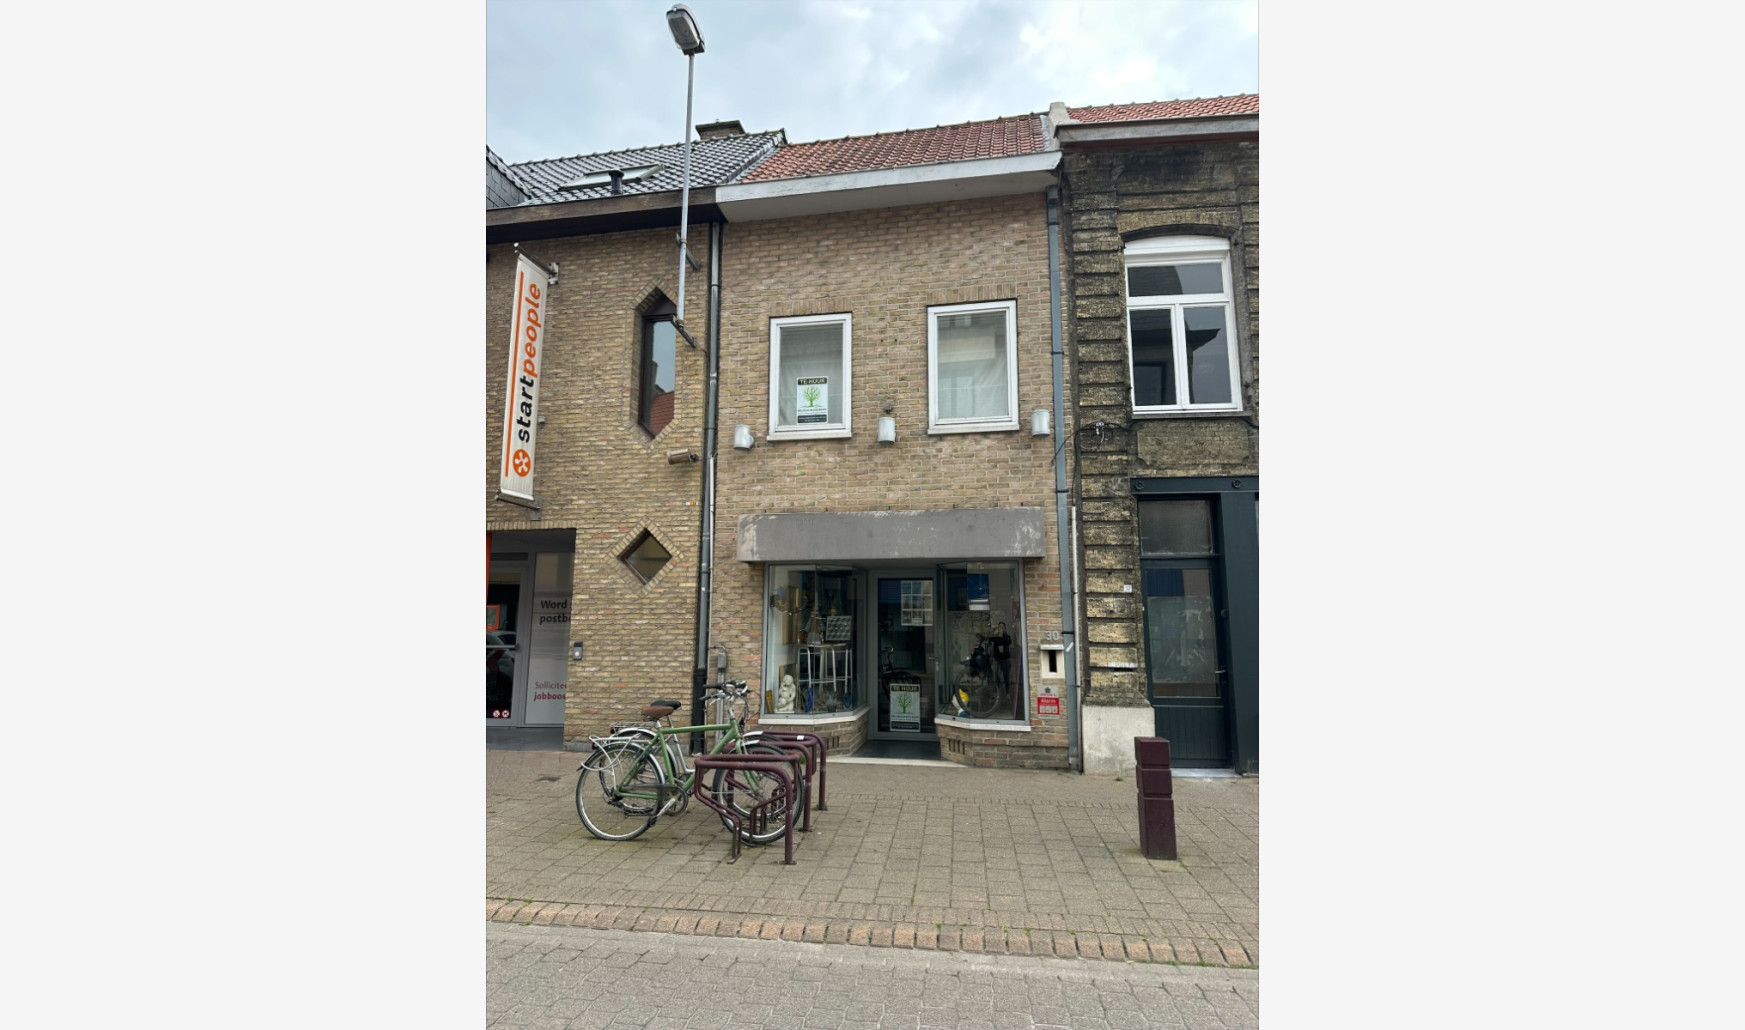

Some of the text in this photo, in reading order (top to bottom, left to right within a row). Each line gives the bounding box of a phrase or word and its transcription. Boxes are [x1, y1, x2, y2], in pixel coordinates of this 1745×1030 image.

[517, 283, 541, 443] startpeople
[541, 599, 567, 608] Word
[1046, 631, 1059, 641] 30
